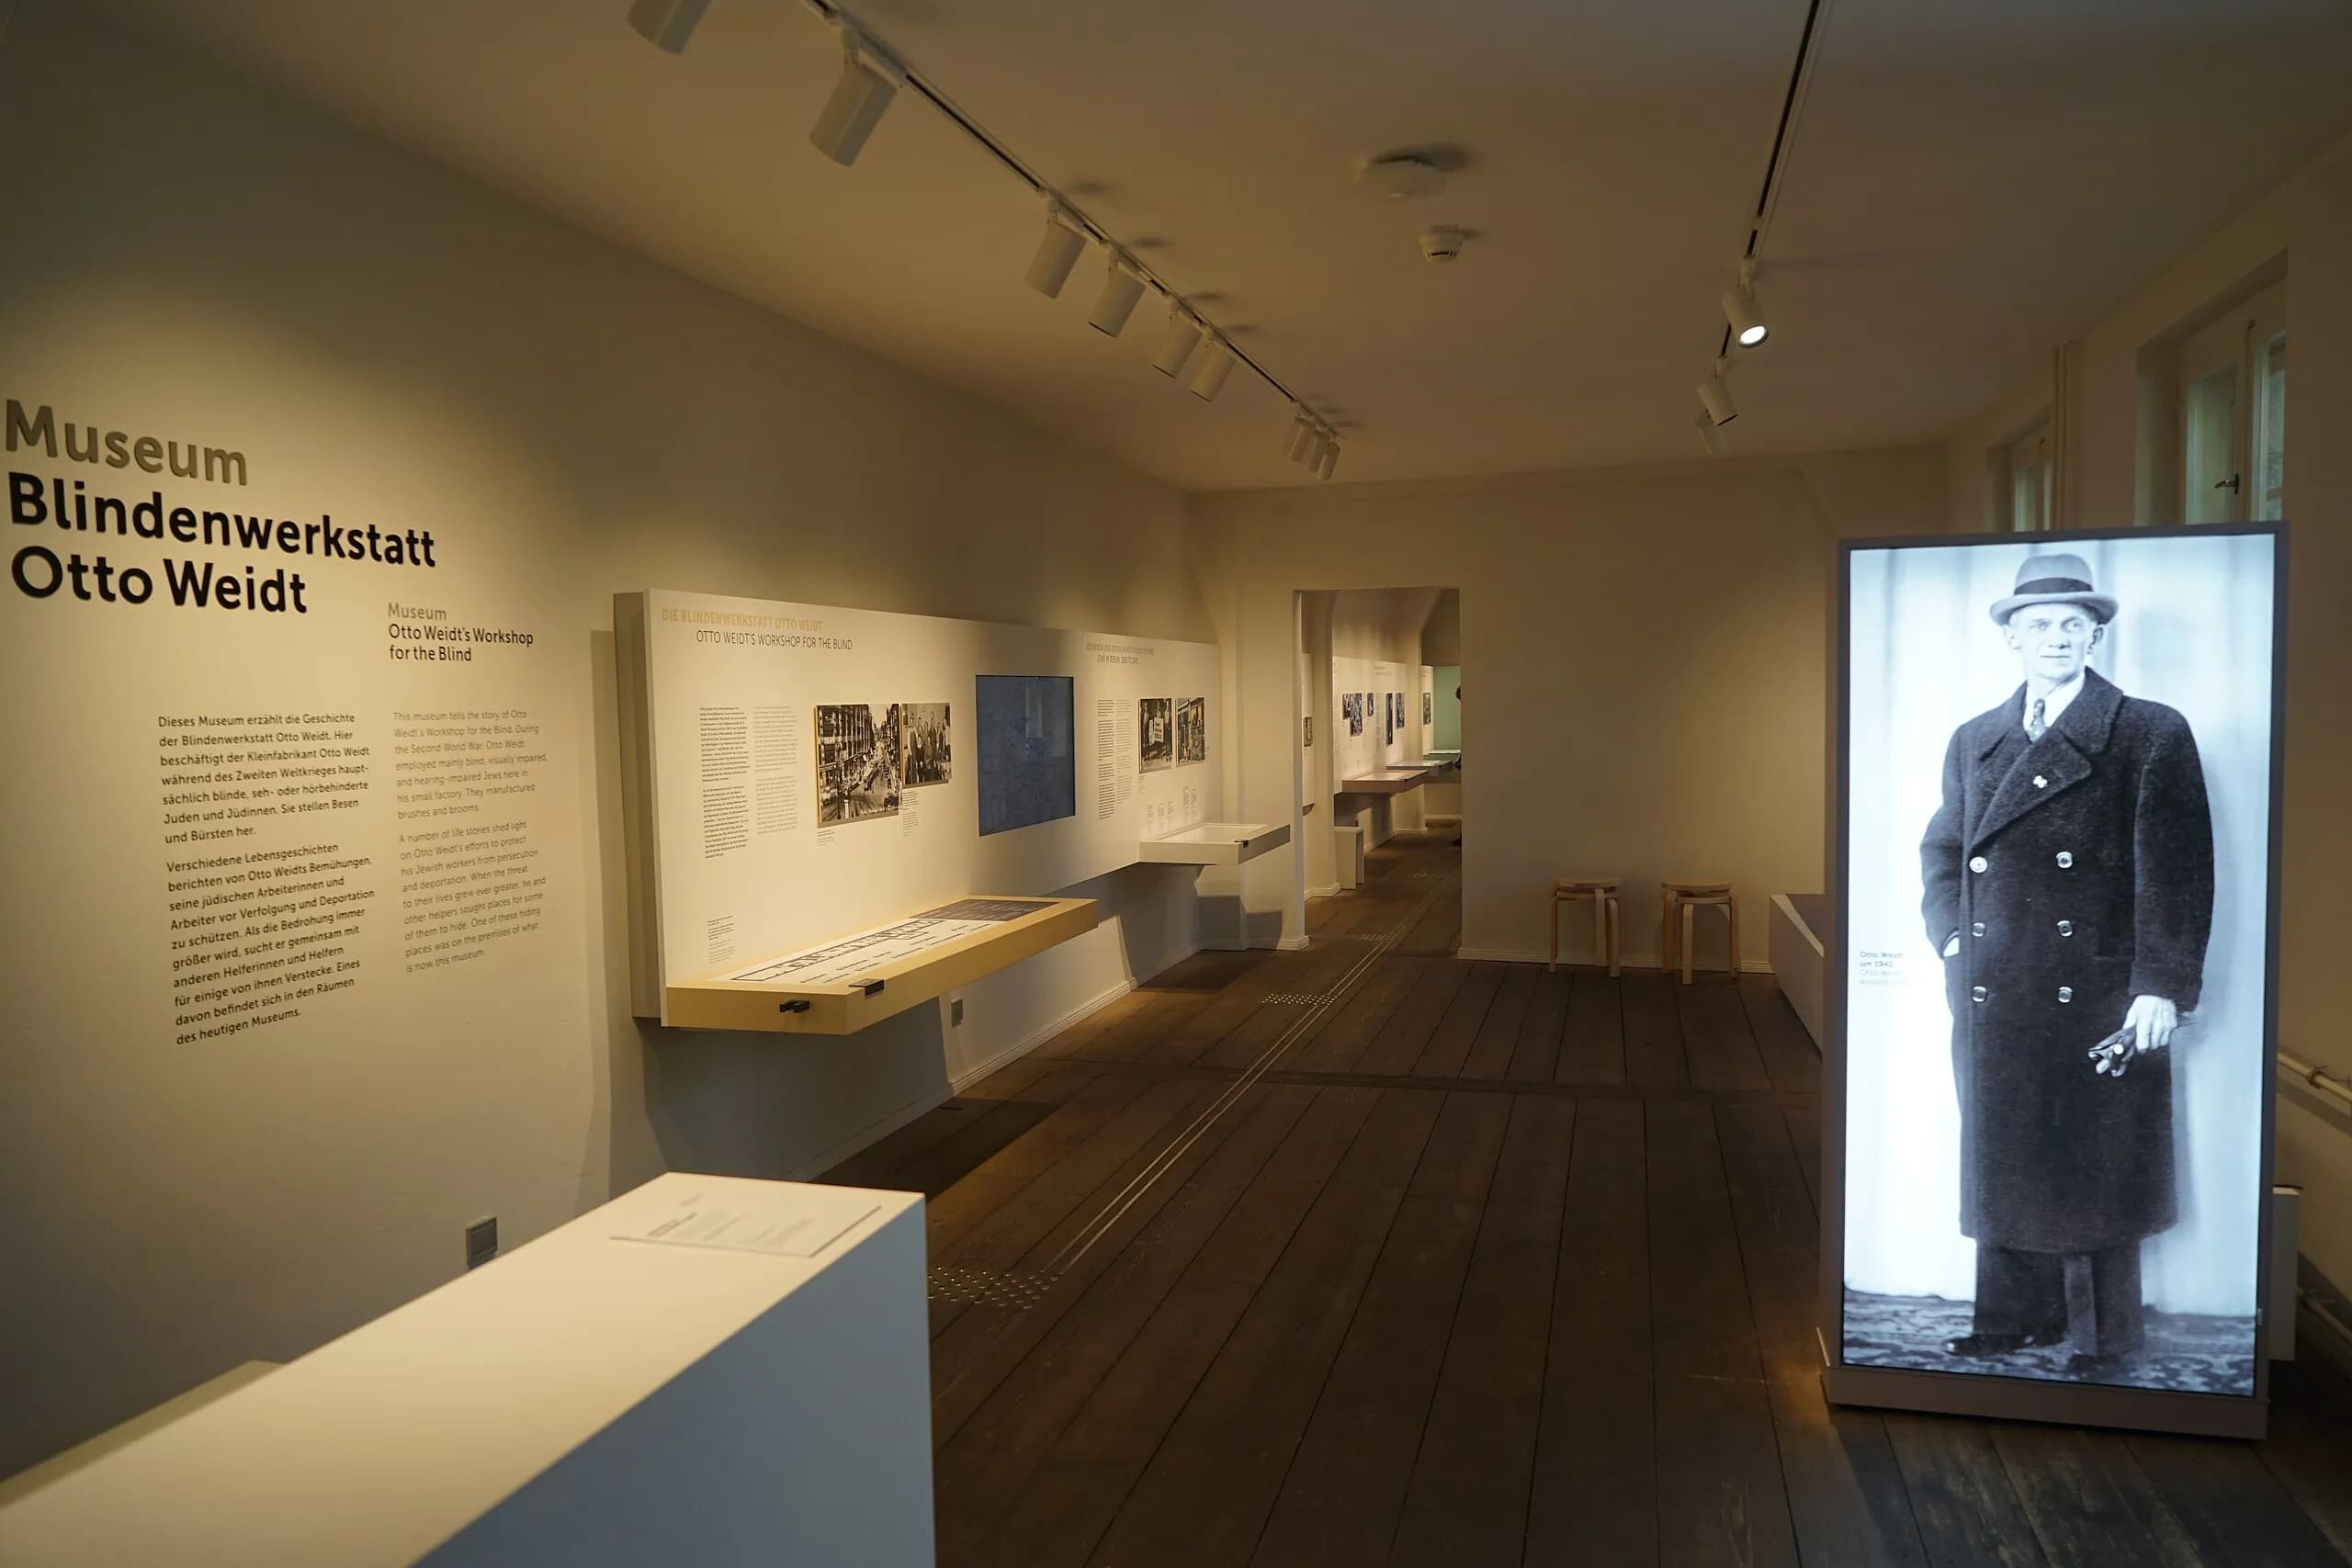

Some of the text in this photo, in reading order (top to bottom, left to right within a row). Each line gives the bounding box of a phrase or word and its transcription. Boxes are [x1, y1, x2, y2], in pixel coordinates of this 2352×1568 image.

[5, 400, 247, 486] Museum
[8, 472, 436, 567] Blindenwerkstatt
[11, 545, 308, 614] Otto Weidt
[388, 603, 447, 621] Museum
[662, 608, 823, 631] DIE BLINDENWERKSTATT OTTO WEIDT
[389, 623, 534, 647] Otto Weidt's Workshop
[696, 630, 853, 650] OTTO WEIDT'S WORKSHOP FOR THE BLIND
[390, 645, 471, 661] for the Blind
[157, 713, 355, 727] Dieses Museum erzählt die Geschichte
[158, 736, 178, 747] der
[181, 733, 274, 746] Blindenwerkstatt
[275, 731, 299, 742] Otto
[333, 729, 353, 739] Hier
[159, 746, 369, 766] beschäftigt der Kleinfabrikant Otto Weidt
[160, 763, 368, 785] während des Zweiten Weltkrieges haupt-
[162, 792, 209, 805] sächlich
[251, 787, 274, 798] seh-
[276, 785, 300, 795] oder
[163, 812, 200, 824] Juden
[201, 809, 224, 820] und
[279, 803, 296, 814] Sie
[297, 800, 330, 812] stellen
[331, 799, 358, 808] Besen
[164, 831, 187, 843] und
[190, 829, 233, 840] Bürsten
[165, 844, 338, 872] Verschiedene Lebensgeschichten
[167, 876, 222, 892] berichten
[224, 874, 245, 884] von
[247, 870, 272, 881] Otto
[273, 864, 307, 876] Weidts
[168, 875, 345, 911] seine jüdischen Arbeiterinnen und
[170, 889, 374, 930] Arbeiter vor Verfolgung und Deportation
[171, 940, 186, 949] zu
[243, 925, 260, 936] Als
[262, 923, 278, 933] die
[279, 914, 334, 930] Bedrohung
[334, 908, 365, 919] immer
[172, 953, 211, 971] größer
[243, 942, 273, 955] sucht
[274, 940, 286, 949] er
[287, 930, 343, 949] gemeinsam
[344, 925, 359, 935] mit
[173, 947, 344, 987] anderen Helferinnen und Helfern
[174, 995, 191, 1007] für
[193, 988, 229, 1002] einige
[230, 984, 252, 994] von
[253, 976, 283, 989] ihnen
[335, 960, 360, 971] Eines
[175, 978, 355, 1025] davon befindet sich in den Räumen
[175, 1032, 197, 1044] des
[198, 1021, 249, 1039] heutigen
